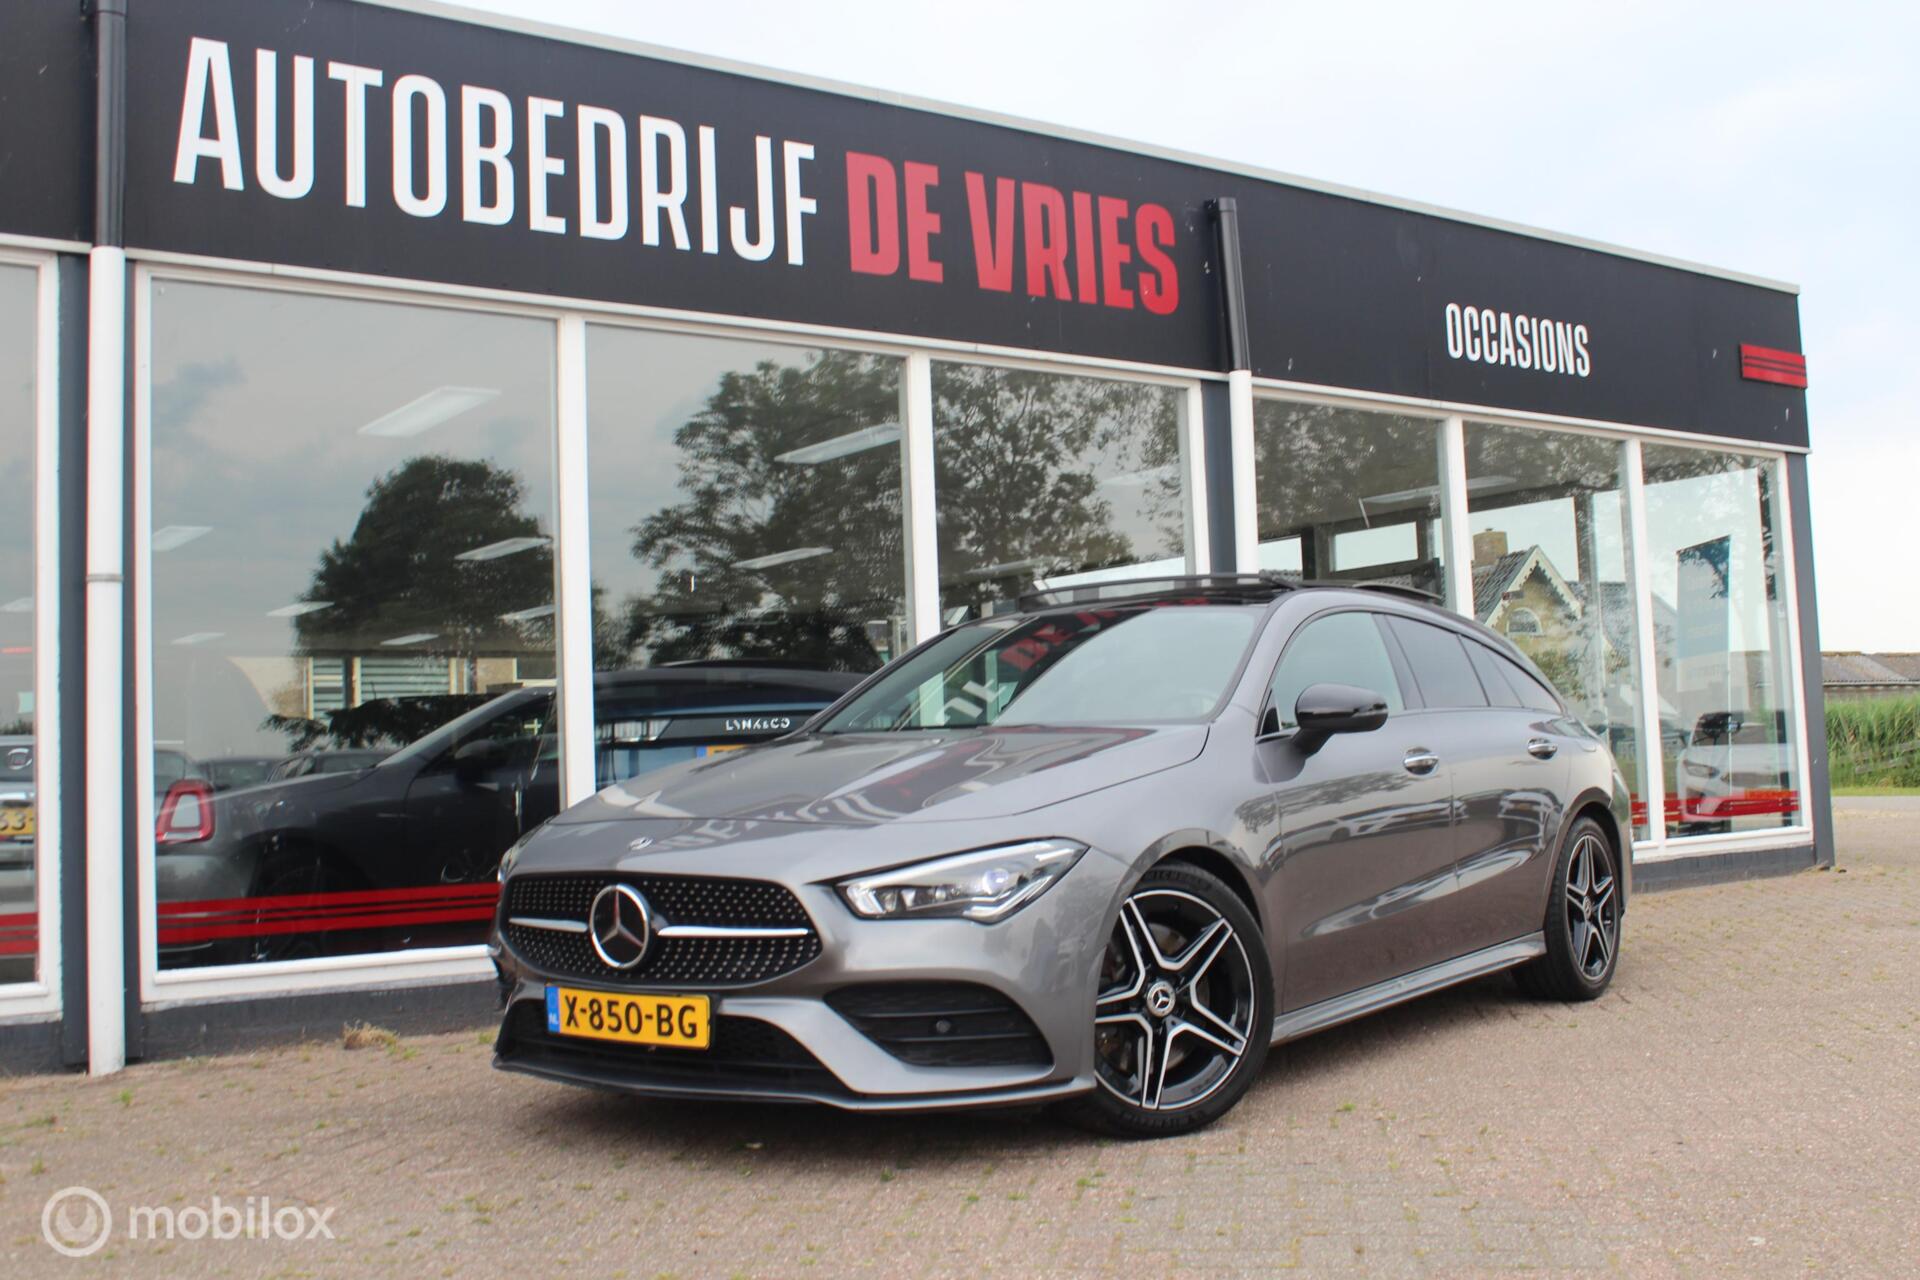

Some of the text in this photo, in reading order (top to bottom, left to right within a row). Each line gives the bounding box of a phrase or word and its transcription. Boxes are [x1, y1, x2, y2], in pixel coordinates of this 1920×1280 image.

[173, 36, 1180, 316] AUTOBEDRIJF DE VRIES
[1445, 302, 1591, 378] OCCASIONS
[564, 994, 698, 1039] X-850-BG
